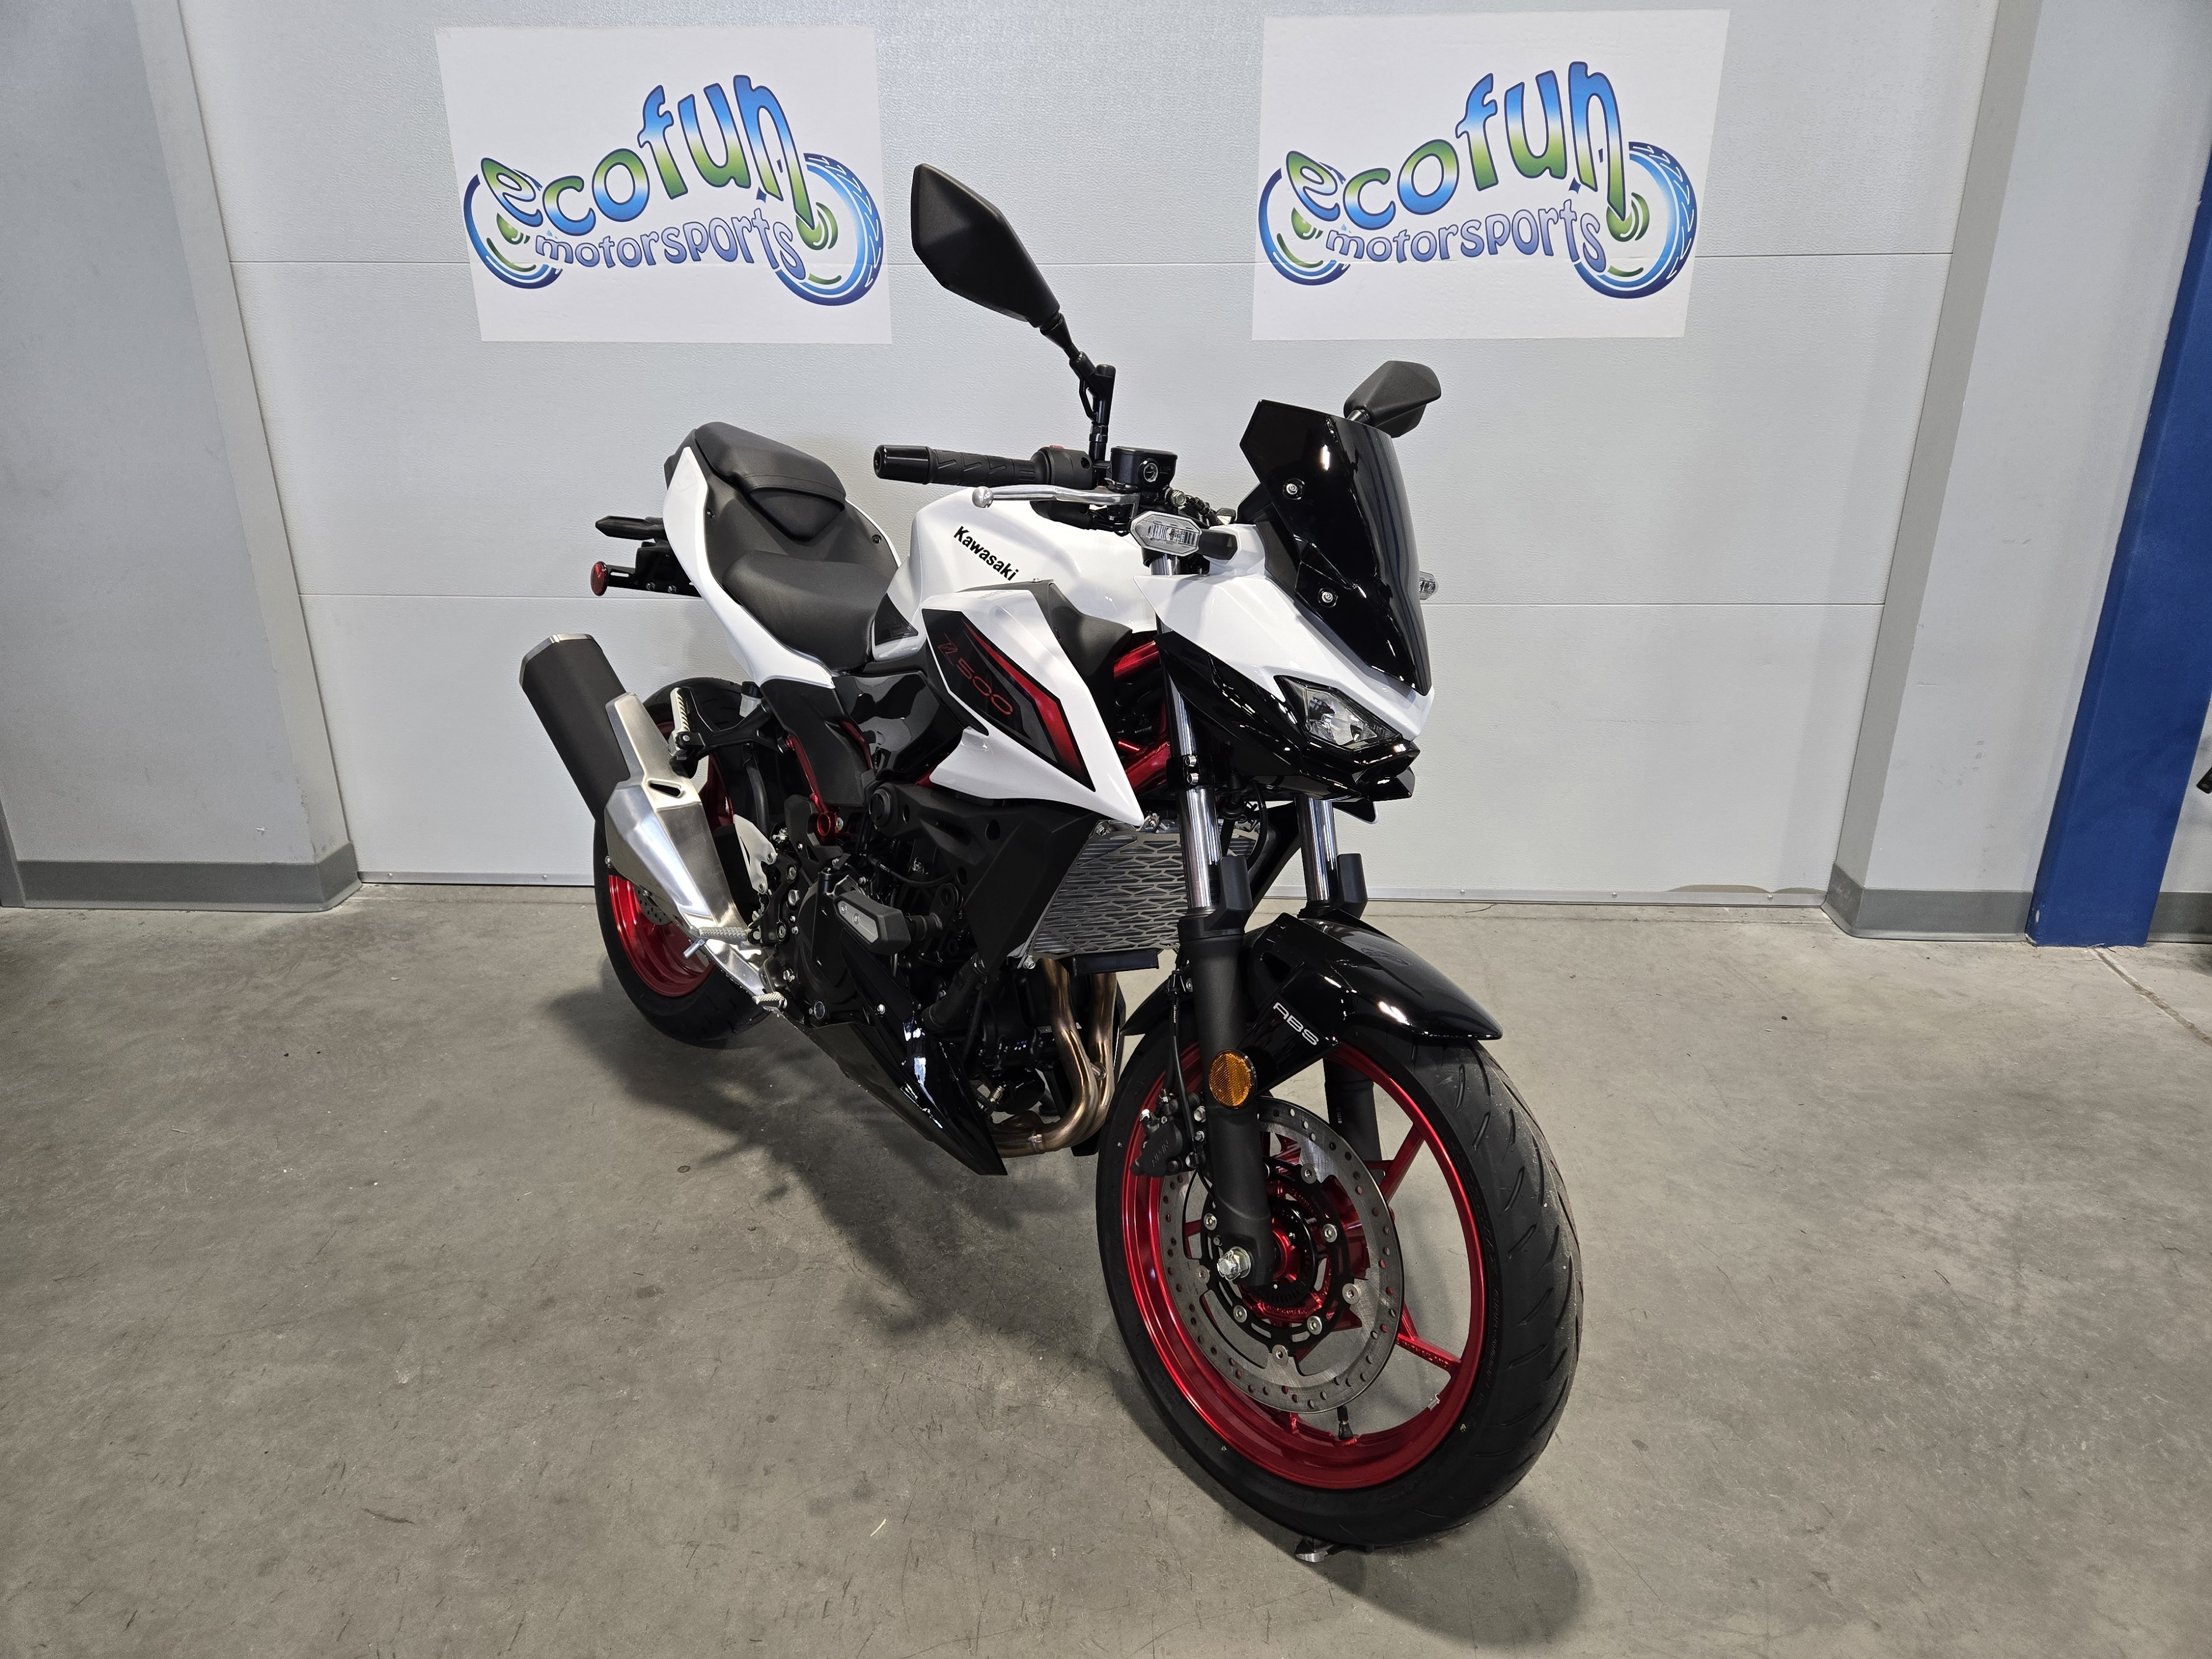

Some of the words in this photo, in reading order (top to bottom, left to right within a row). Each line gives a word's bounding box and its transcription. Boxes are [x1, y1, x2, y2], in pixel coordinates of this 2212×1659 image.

[535, 208, 807, 280] motorsports
[1326, 199, 1606, 273] motorsports
[953, 526, 1019, 581] Kawasaki
[1273, 1002, 1319, 1045] ABS
